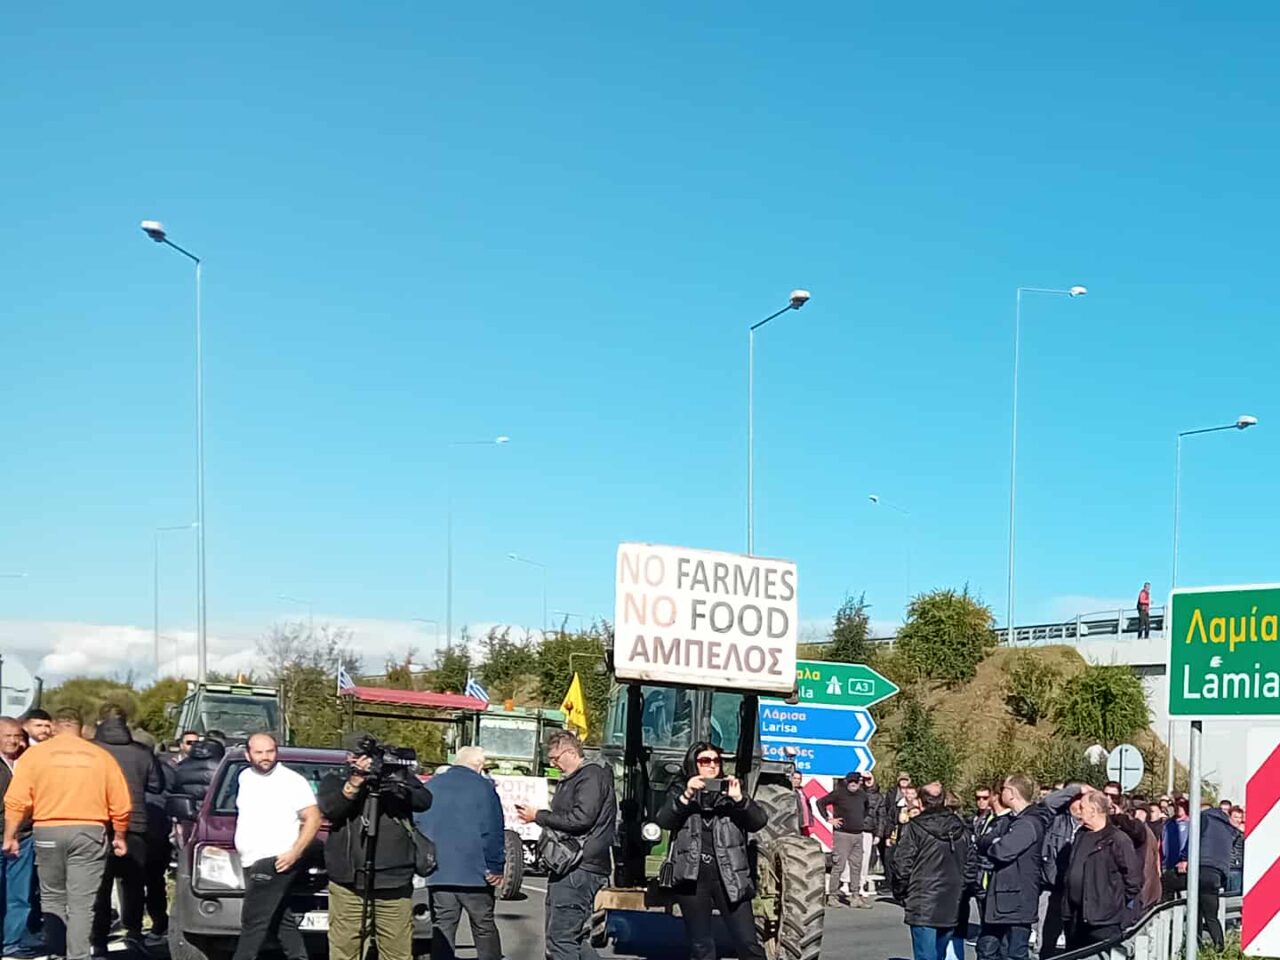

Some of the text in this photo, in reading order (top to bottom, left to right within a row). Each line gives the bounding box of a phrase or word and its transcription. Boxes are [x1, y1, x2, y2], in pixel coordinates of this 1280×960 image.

[620, 551, 795, 602] NO FARMES
[623, 592, 789, 639] NO FOOD
[1185, 606, 1279, 652] Λαμία
[628, 634, 783, 676] ΑΜΠΕΛΟΣ
[854, 682, 869, 692] A3
[762, 722, 798, 733] Larisa
[763, 708, 807, 721] Λάρισα
